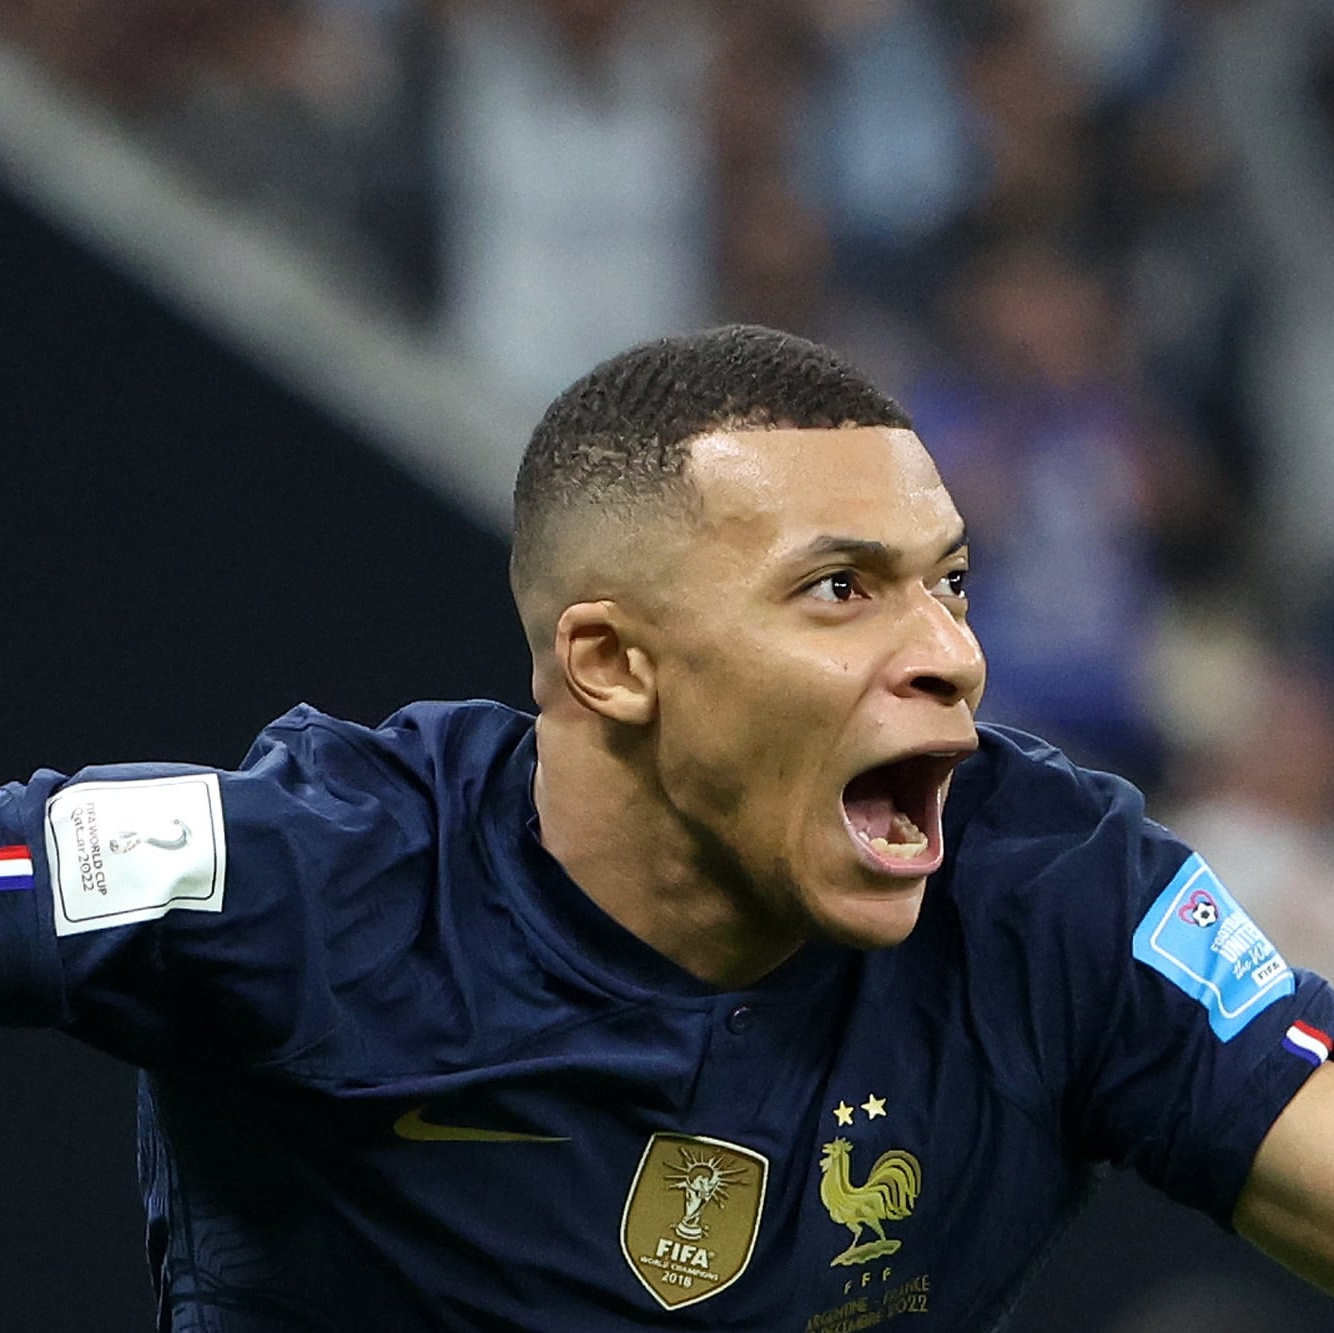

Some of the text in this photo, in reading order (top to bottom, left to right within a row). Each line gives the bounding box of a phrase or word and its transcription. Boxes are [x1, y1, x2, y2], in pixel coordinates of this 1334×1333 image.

[89, 825, 103, 869] WORLD
[95, 871, 108, 896] CUP
[656, 1238, 709, 1269] FIFA
